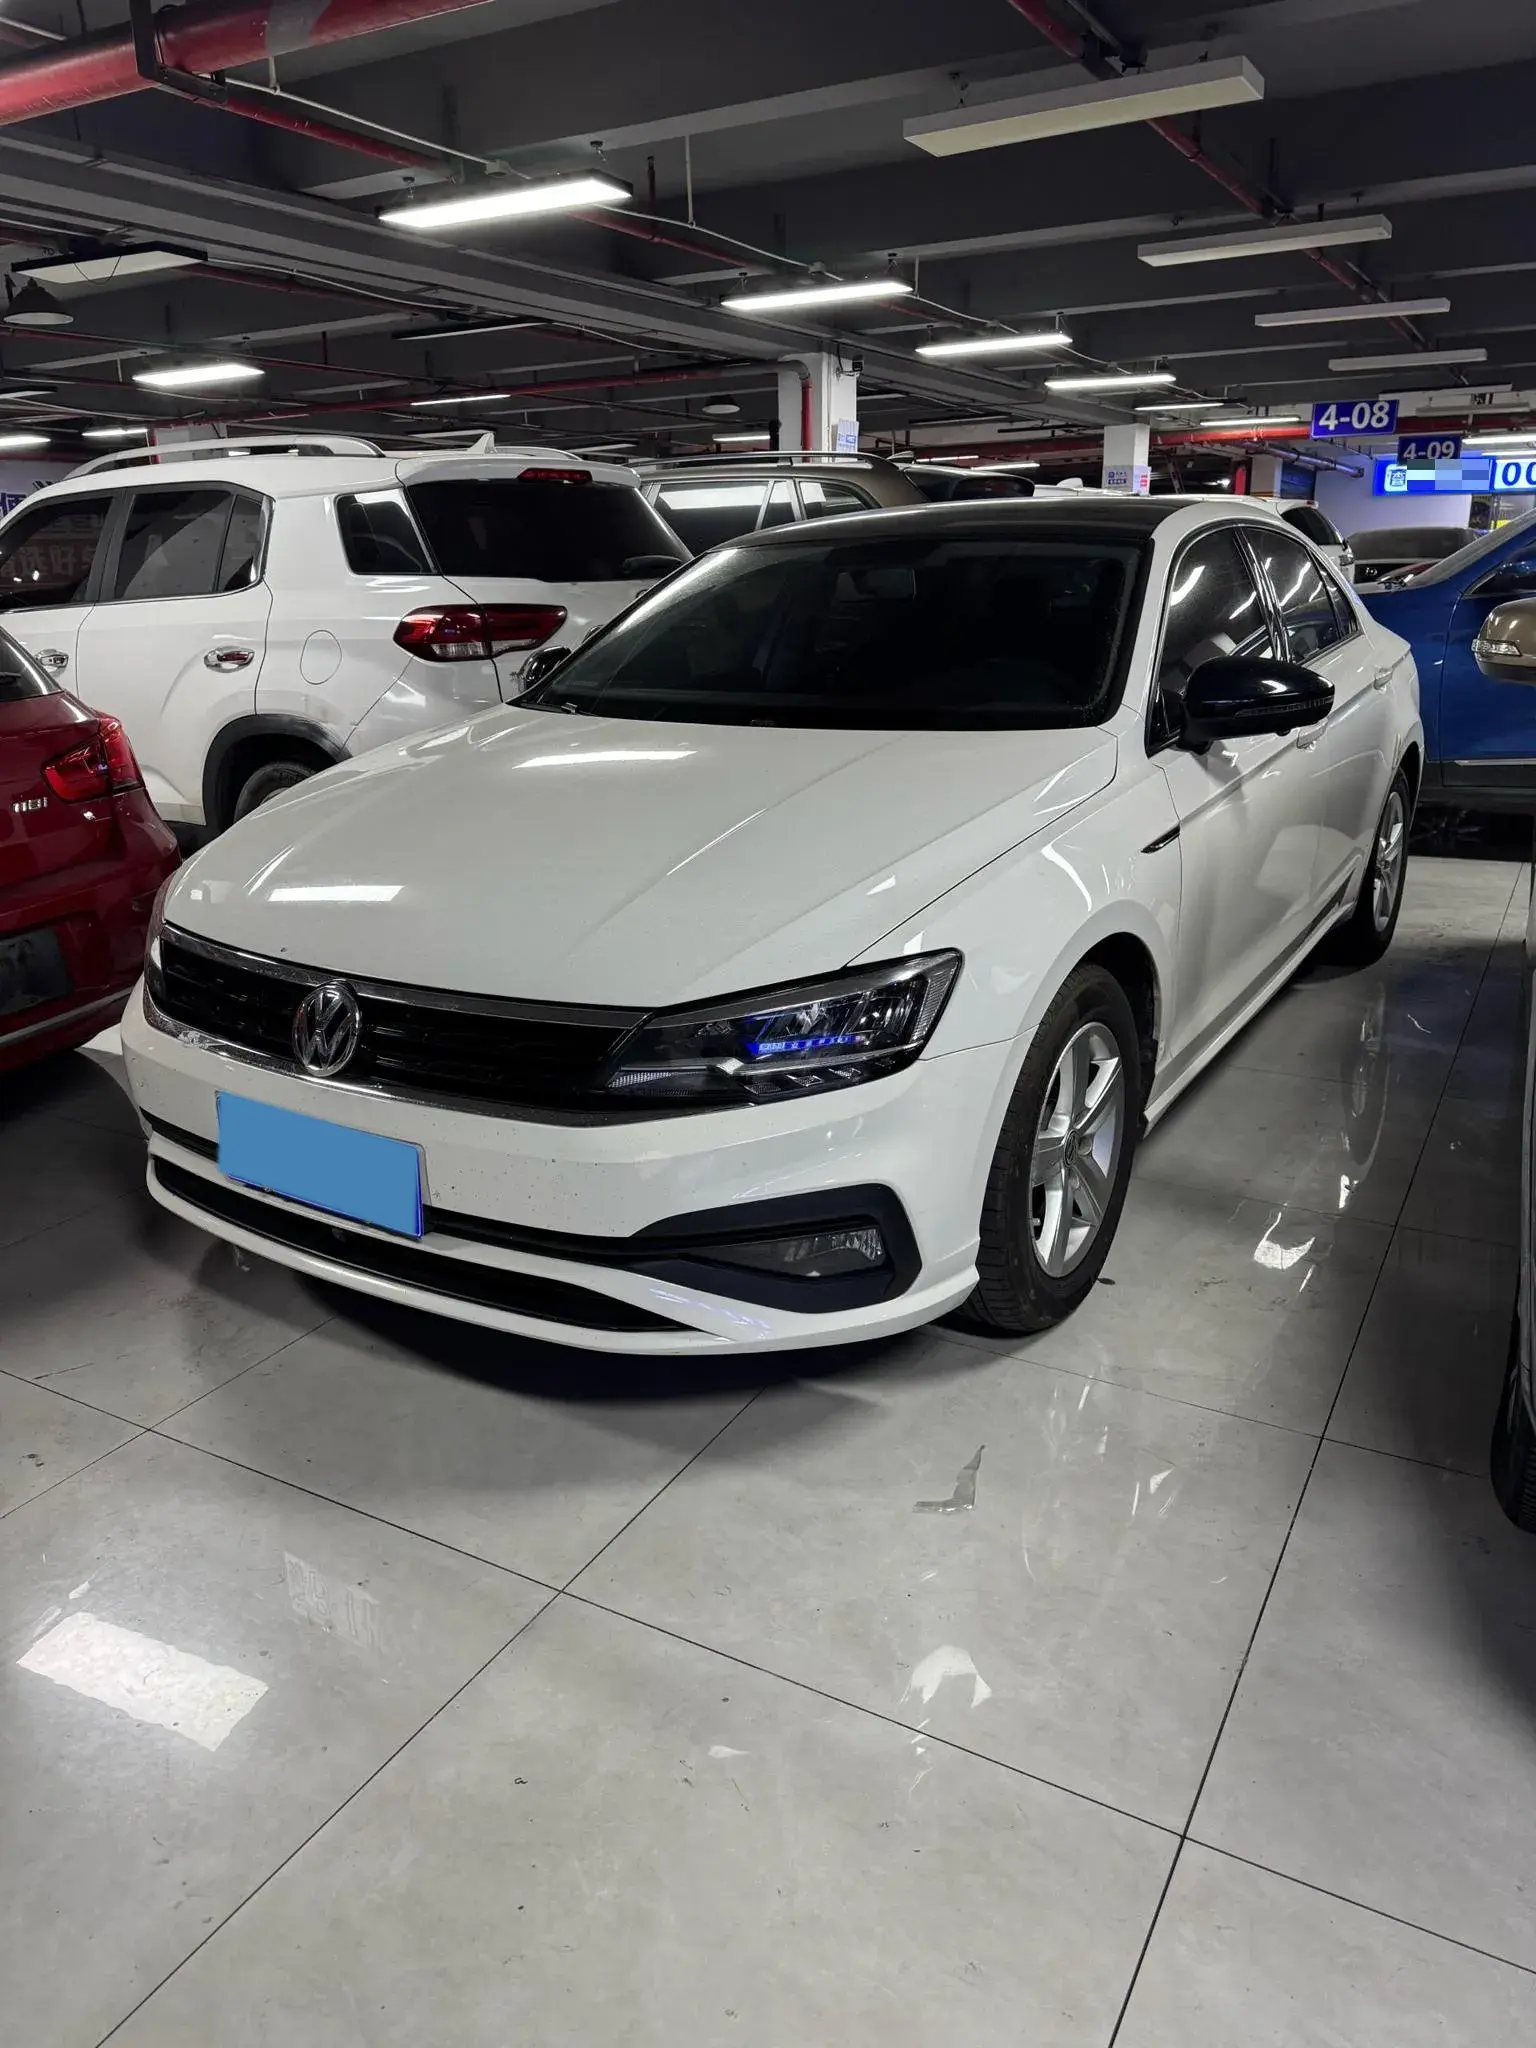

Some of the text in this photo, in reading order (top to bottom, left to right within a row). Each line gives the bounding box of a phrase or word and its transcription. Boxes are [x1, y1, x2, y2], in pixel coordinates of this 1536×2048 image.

[1319, 401, 1390, 431] 4-08
[1403, 440, 1456, 460] 4-09
[294, 983, 359, 1076] VW
